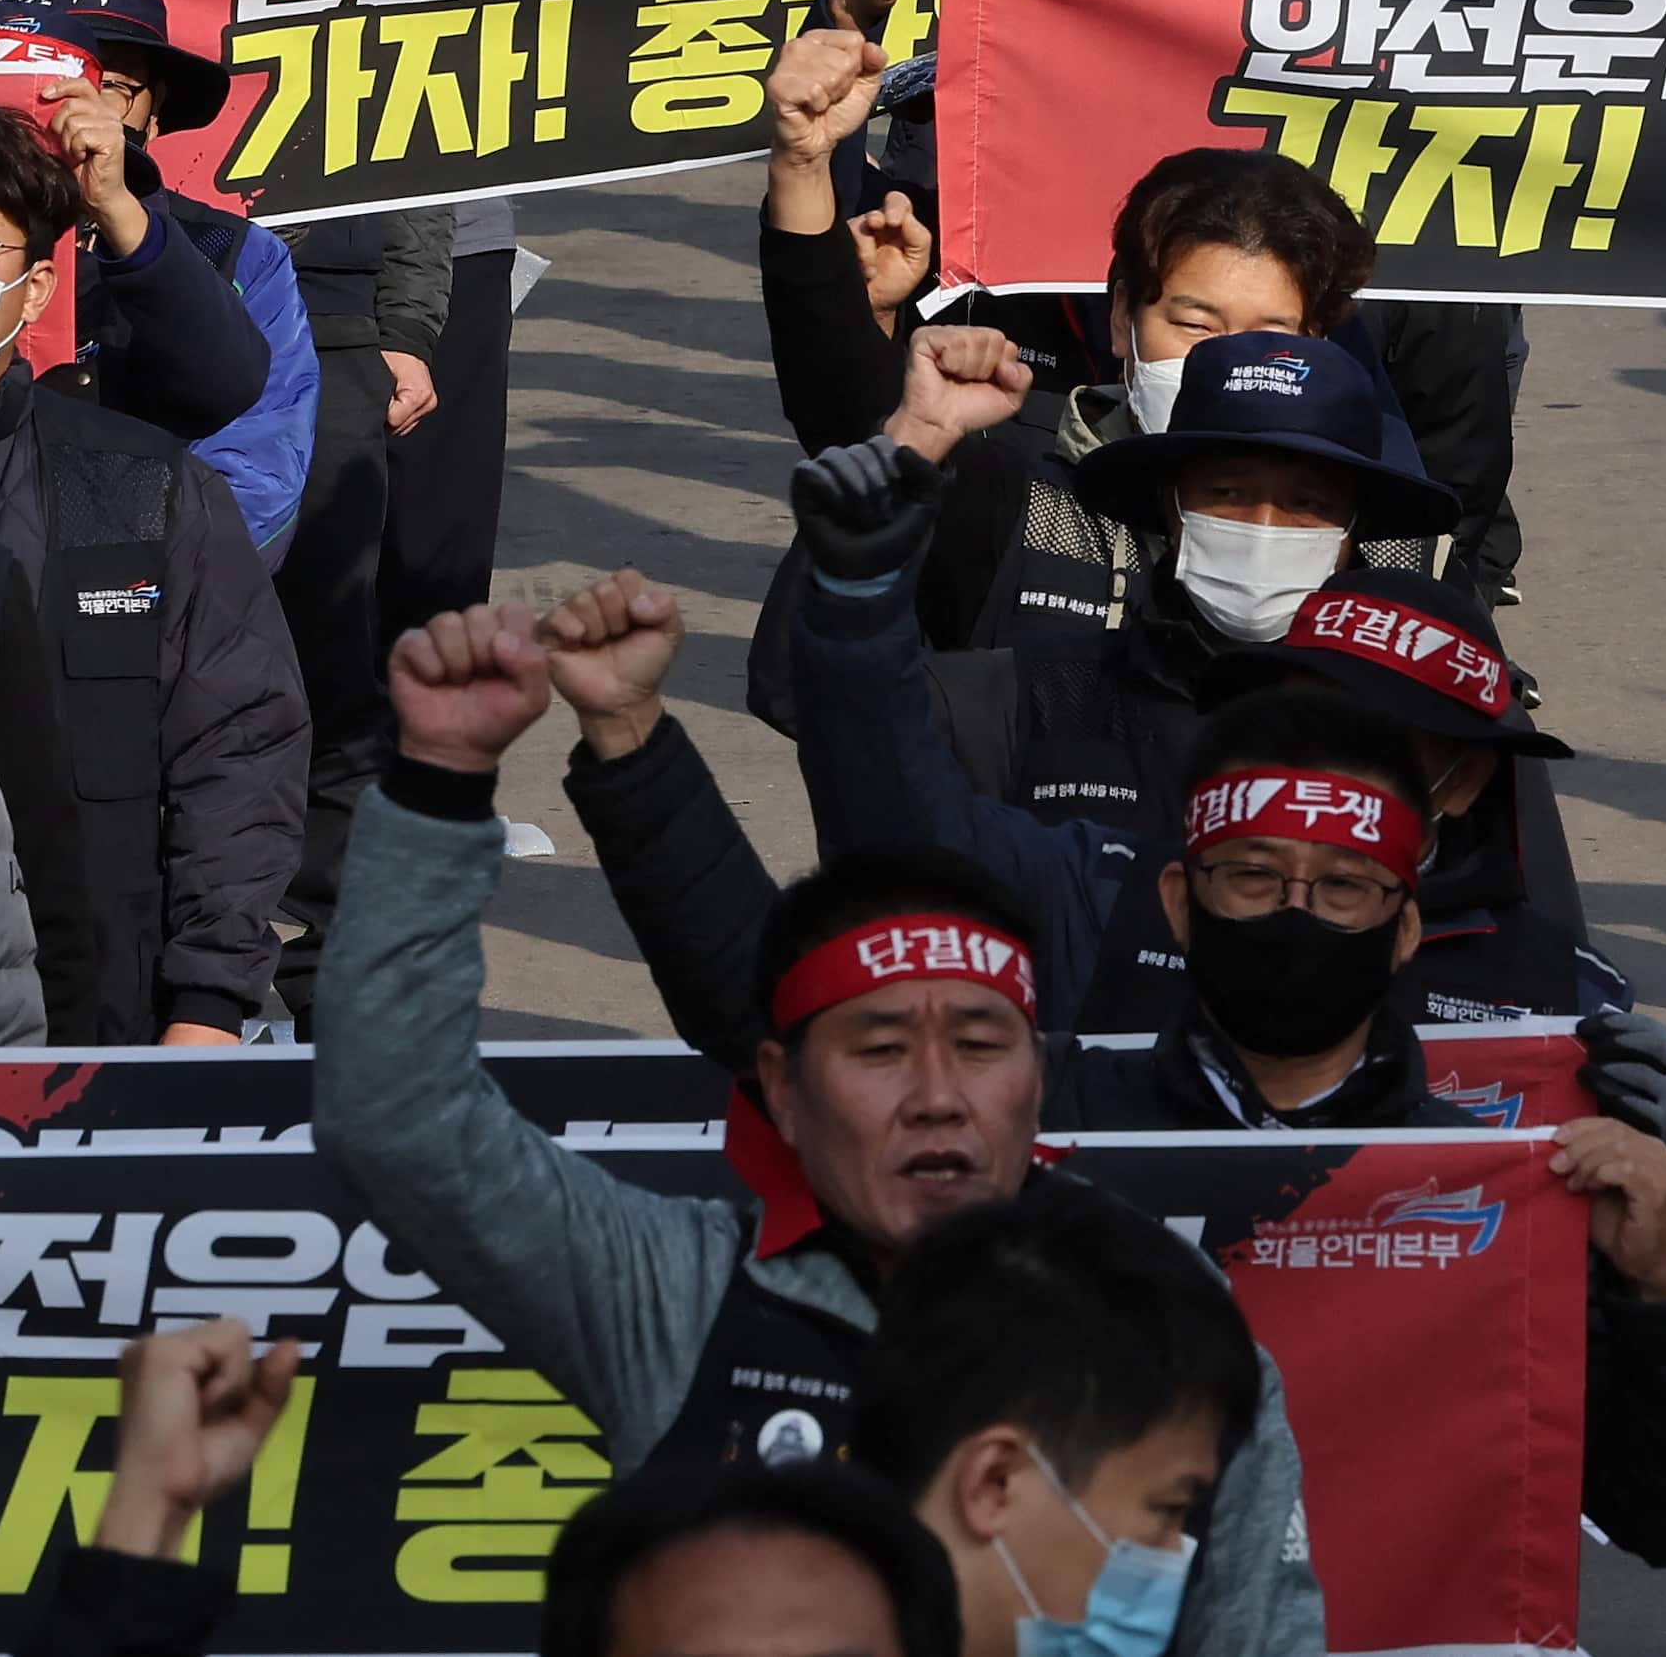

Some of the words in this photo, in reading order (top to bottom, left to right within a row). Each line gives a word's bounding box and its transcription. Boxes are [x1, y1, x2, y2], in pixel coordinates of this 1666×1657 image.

[1222, 86, 1645, 259] 가자!
[1230, 366, 1297, 382] 화물연대본부
[78, 598, 152, 615] 화물연대본부
[1312, 601, 1396, 649] 단결
[1442, 646, 1503, 702] 투쟁
[1184, 787, 1230, 843] 단결
[1284, 779, 1383, 843] 투쟁
[856, 927, 964, 976] 단결
[1252, 1231, 1461, 1272] 화물연대본부
